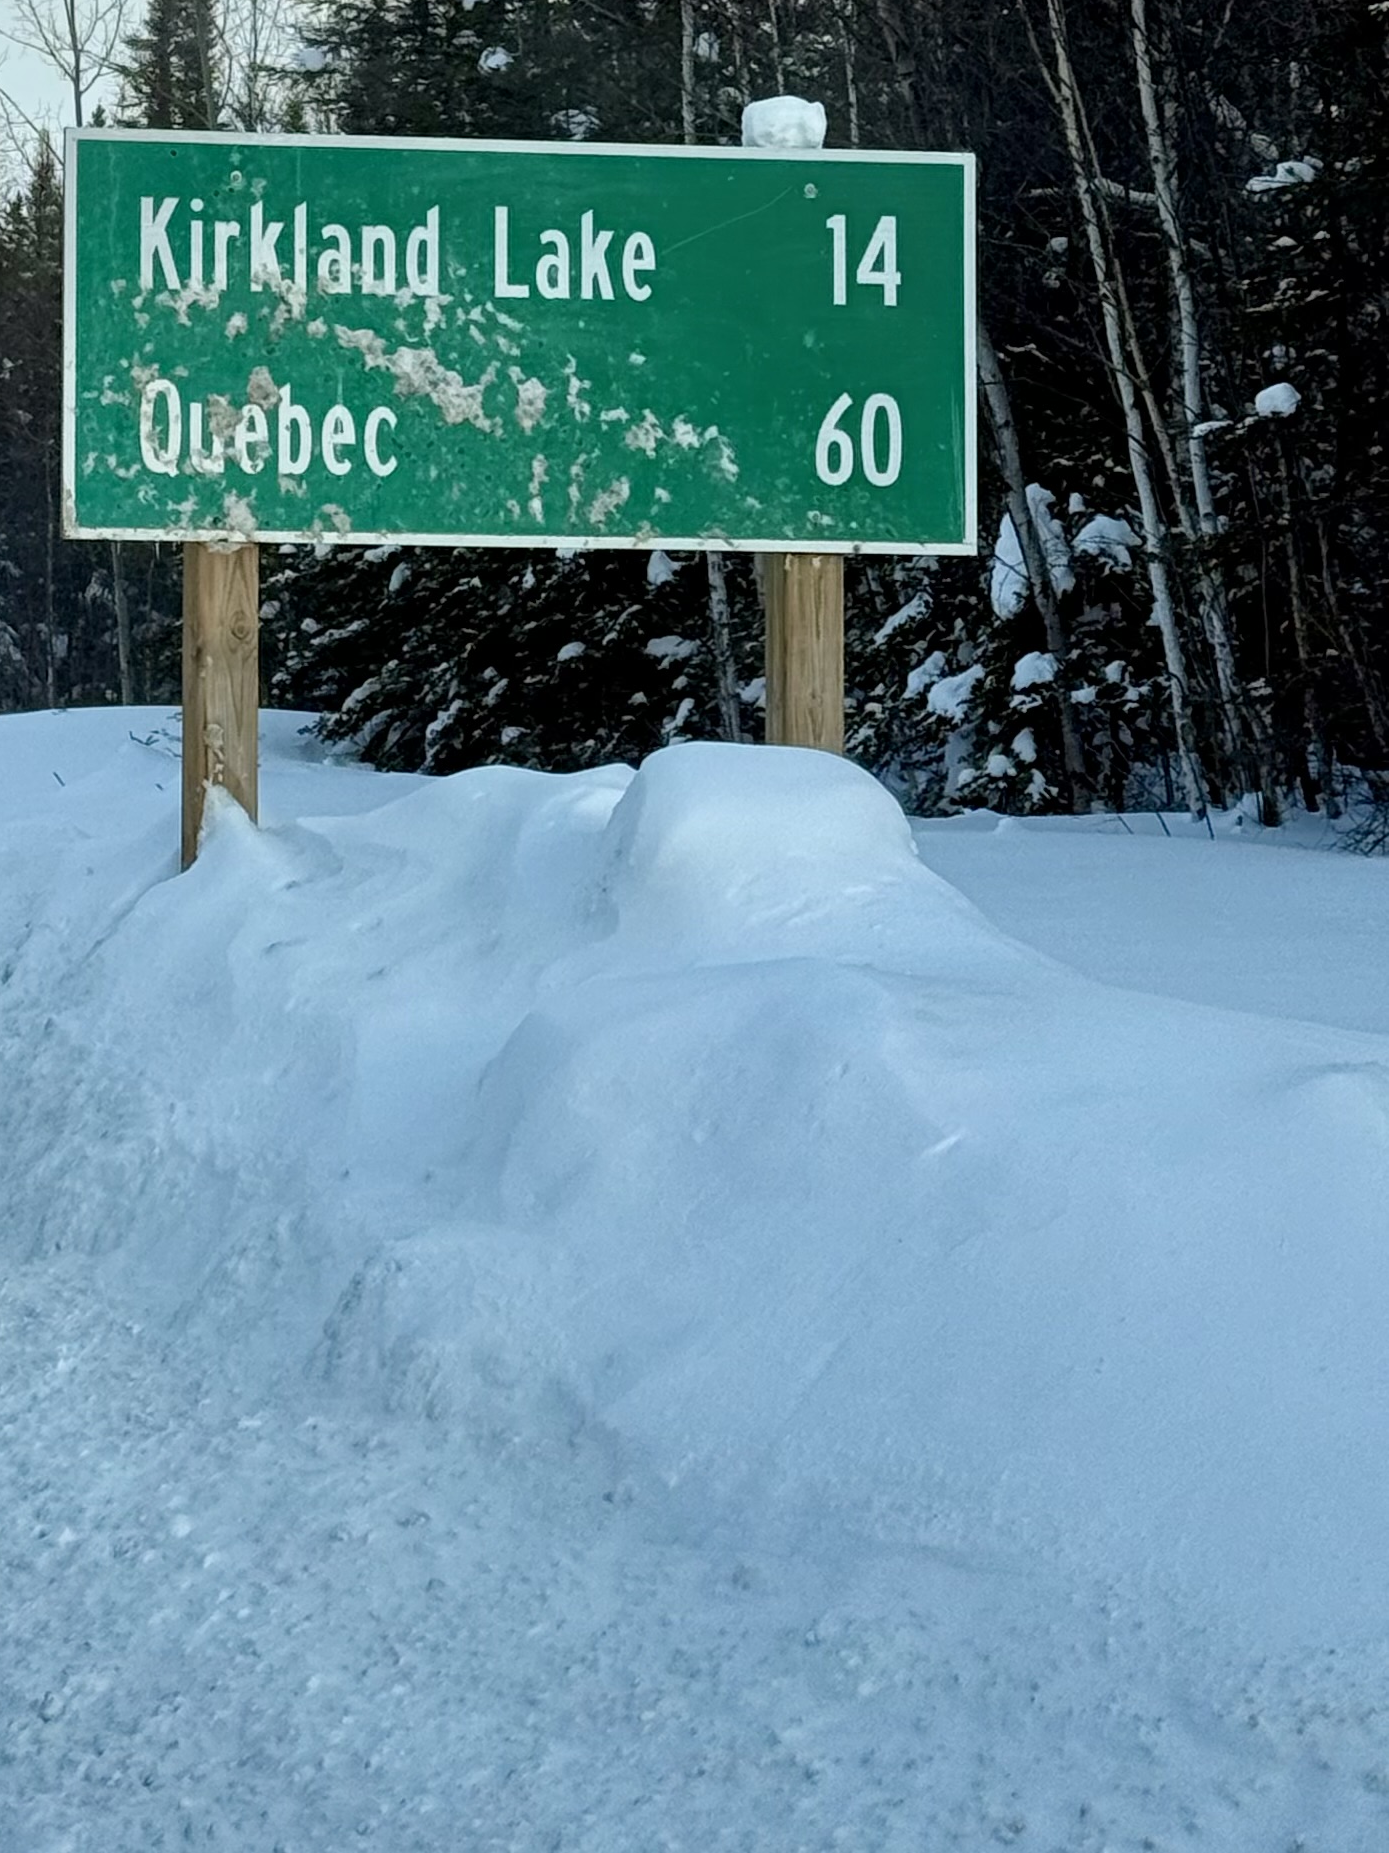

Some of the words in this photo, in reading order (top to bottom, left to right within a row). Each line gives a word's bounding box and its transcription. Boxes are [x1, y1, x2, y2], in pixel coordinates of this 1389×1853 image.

[139, 196, 440, 295] Kirkland
[494, 206, 657, 301] Lake
[825, 214, 902, 306] 14
[140, 378, 398, 478] Quebec
[815, 393, 903, 487] 60
